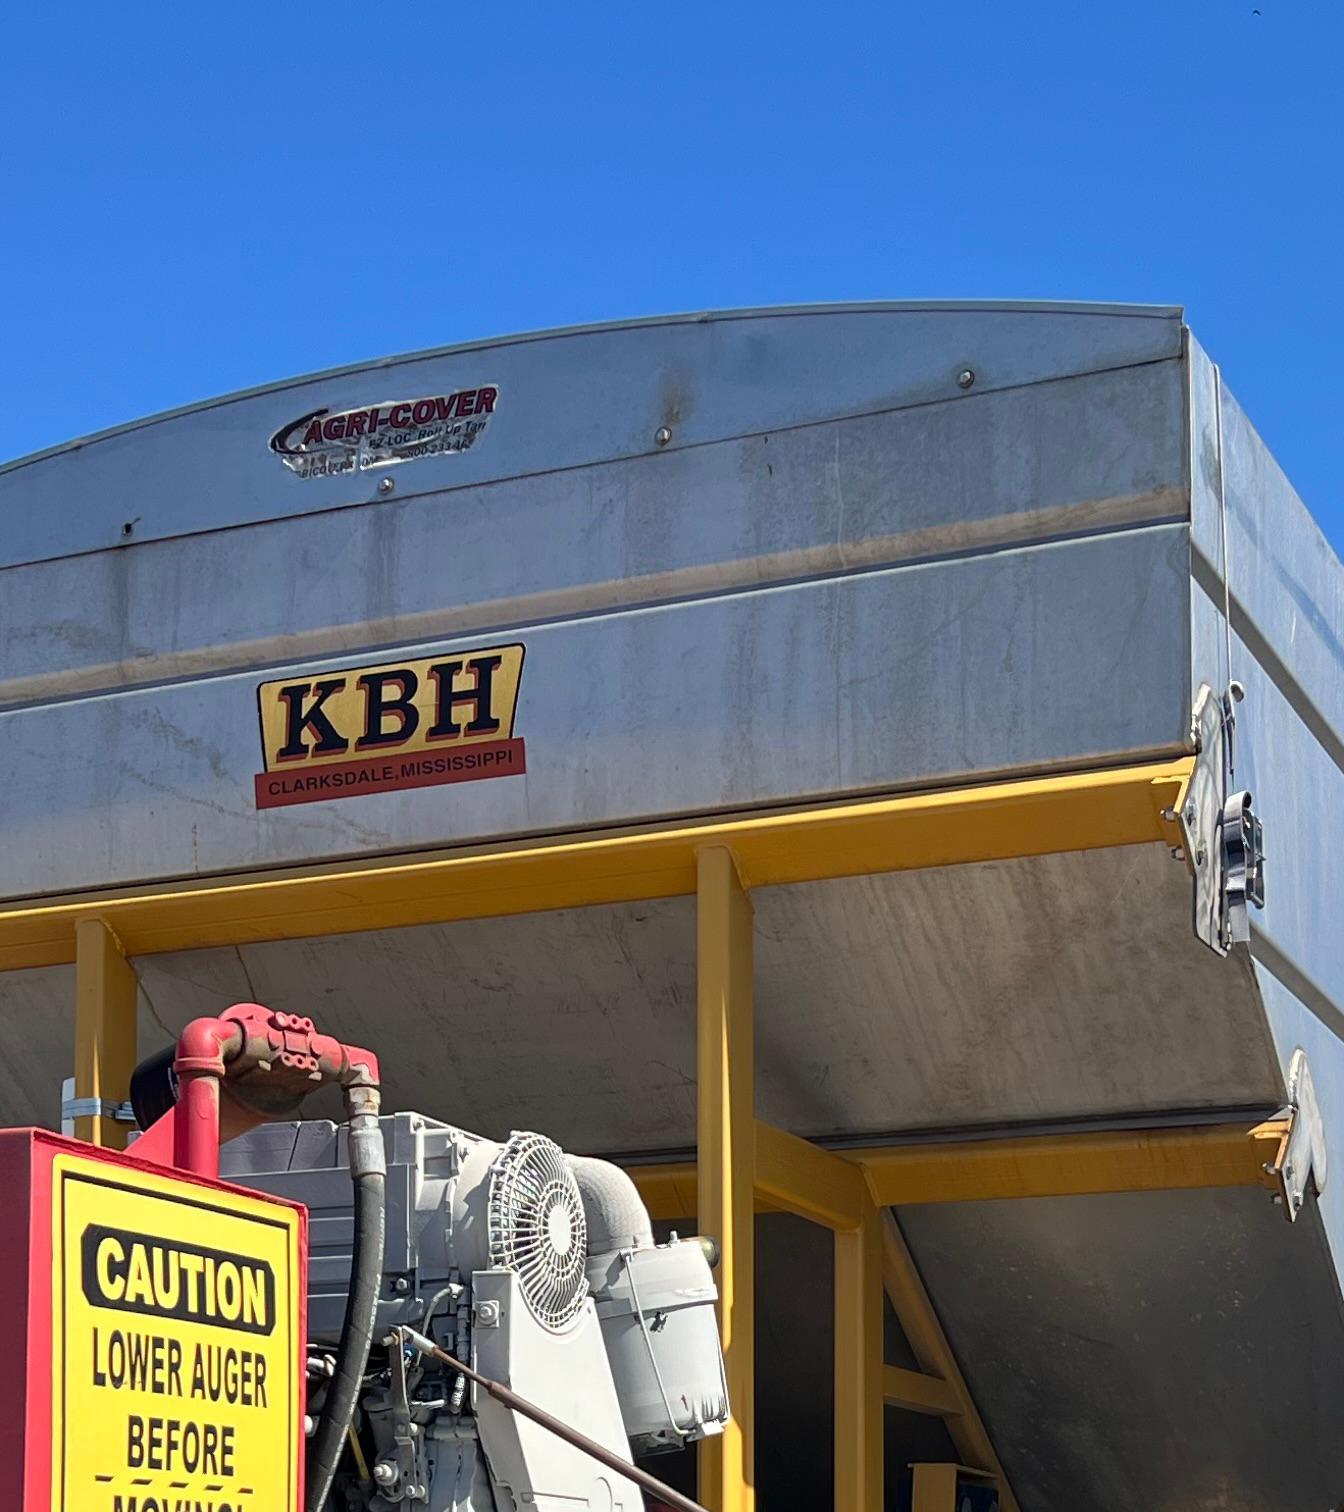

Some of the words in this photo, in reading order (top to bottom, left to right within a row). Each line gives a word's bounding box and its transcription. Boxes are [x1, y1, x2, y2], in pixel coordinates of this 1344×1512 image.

[303, 387, 498, 446] AGRI-COVER
[276, 654, 503, 763] KBH
[267, 766, 400, 796] CLARKSDALE,
[401, 749, 513, 778] MISSISSIPPI
[96, 1236, 266, 1326] CAUTION
[92, 1326, 182, 1395] LOWER
[191, 1342, 267, 1408] AUGER
[127, 1414, 235, 1477] BEFORE
